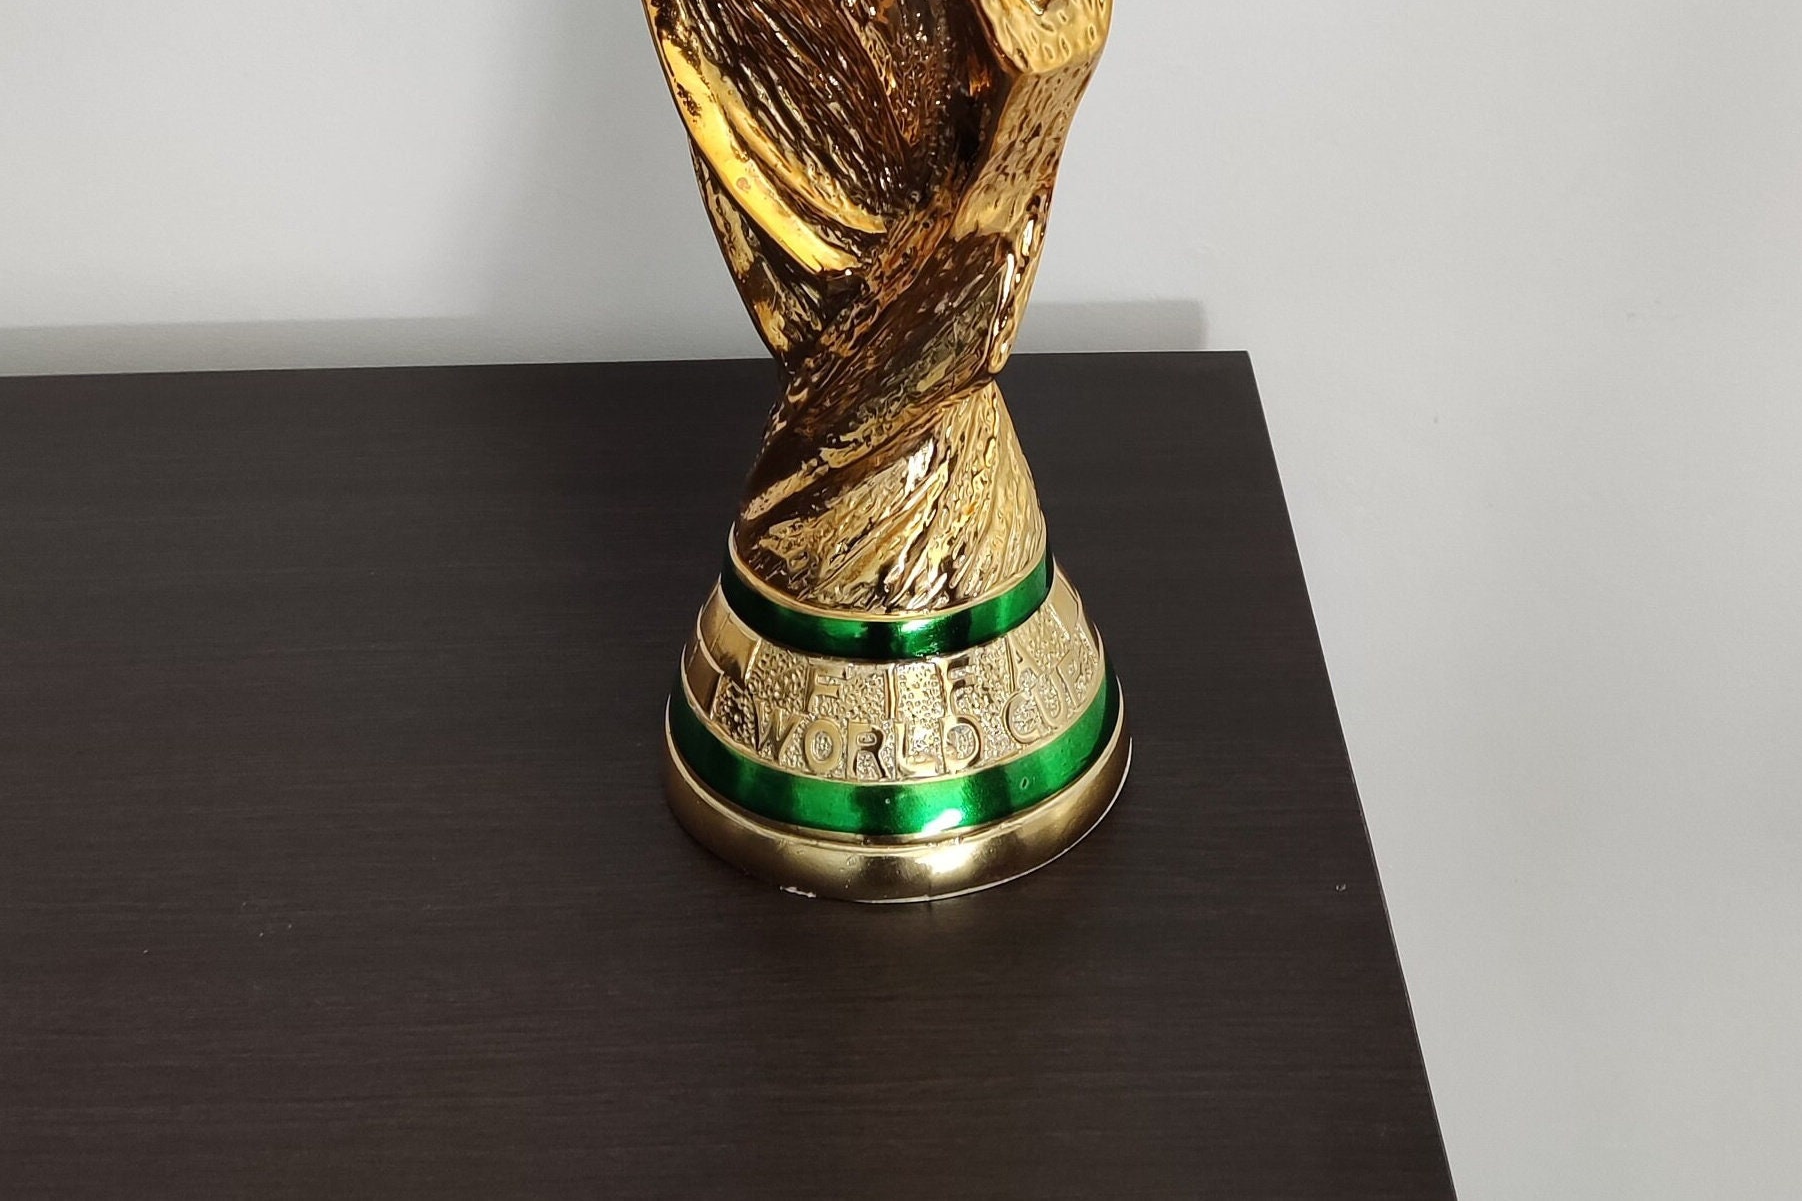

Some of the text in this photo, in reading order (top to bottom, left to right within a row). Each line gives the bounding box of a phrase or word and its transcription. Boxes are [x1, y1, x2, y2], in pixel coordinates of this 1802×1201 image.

[751, 650, 1084, 779] WORLD CUP
[803, 634, 1043, 722] FIFA
